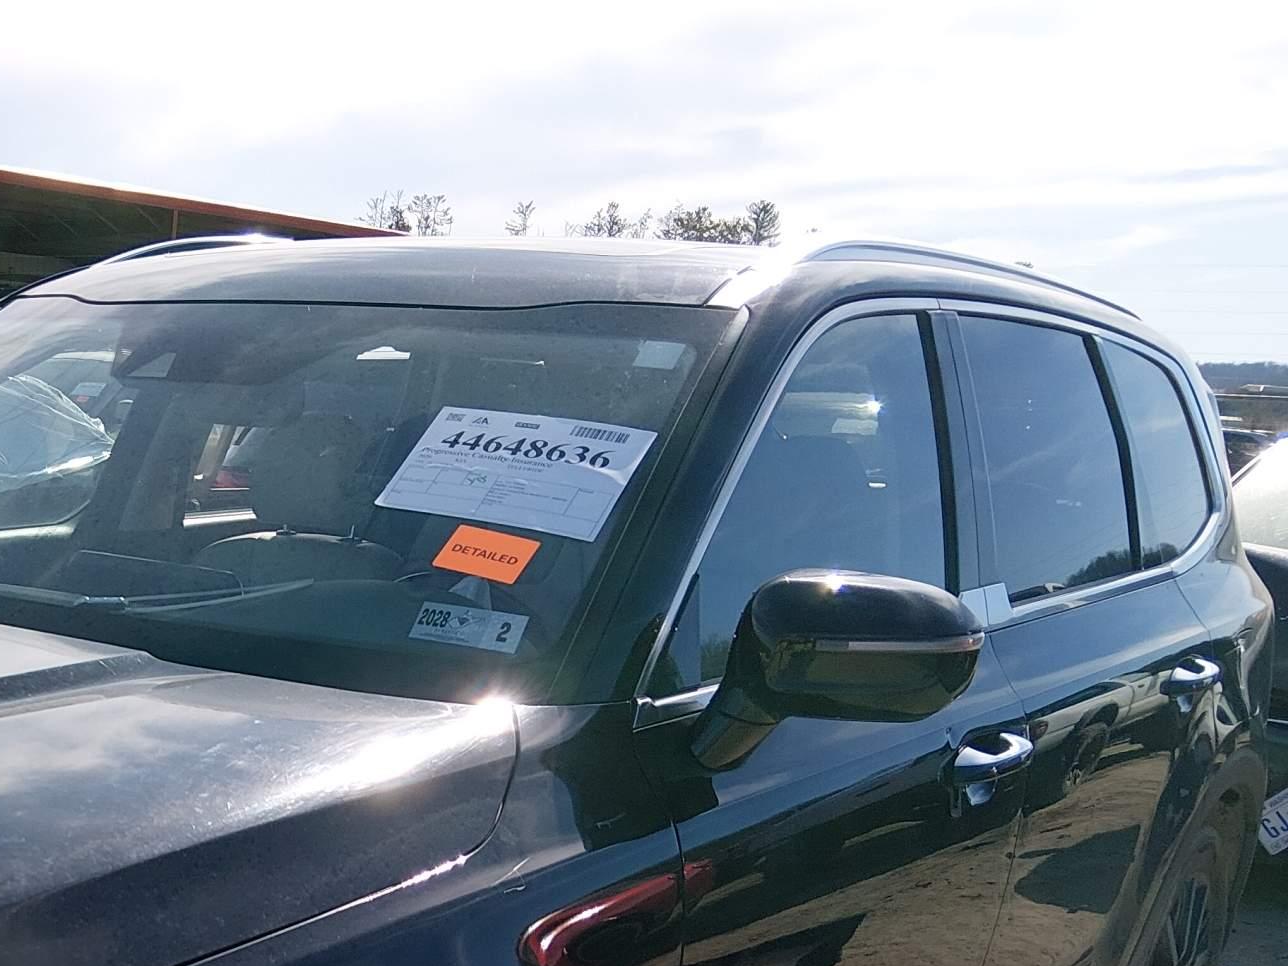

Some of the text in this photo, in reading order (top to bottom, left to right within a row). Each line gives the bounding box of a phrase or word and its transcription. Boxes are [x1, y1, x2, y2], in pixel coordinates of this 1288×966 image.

[441, 431, 617, 469] 44648636
[451, 543, 519, 566] DETAILED
[417, 608, 512, 642] 2028 2
